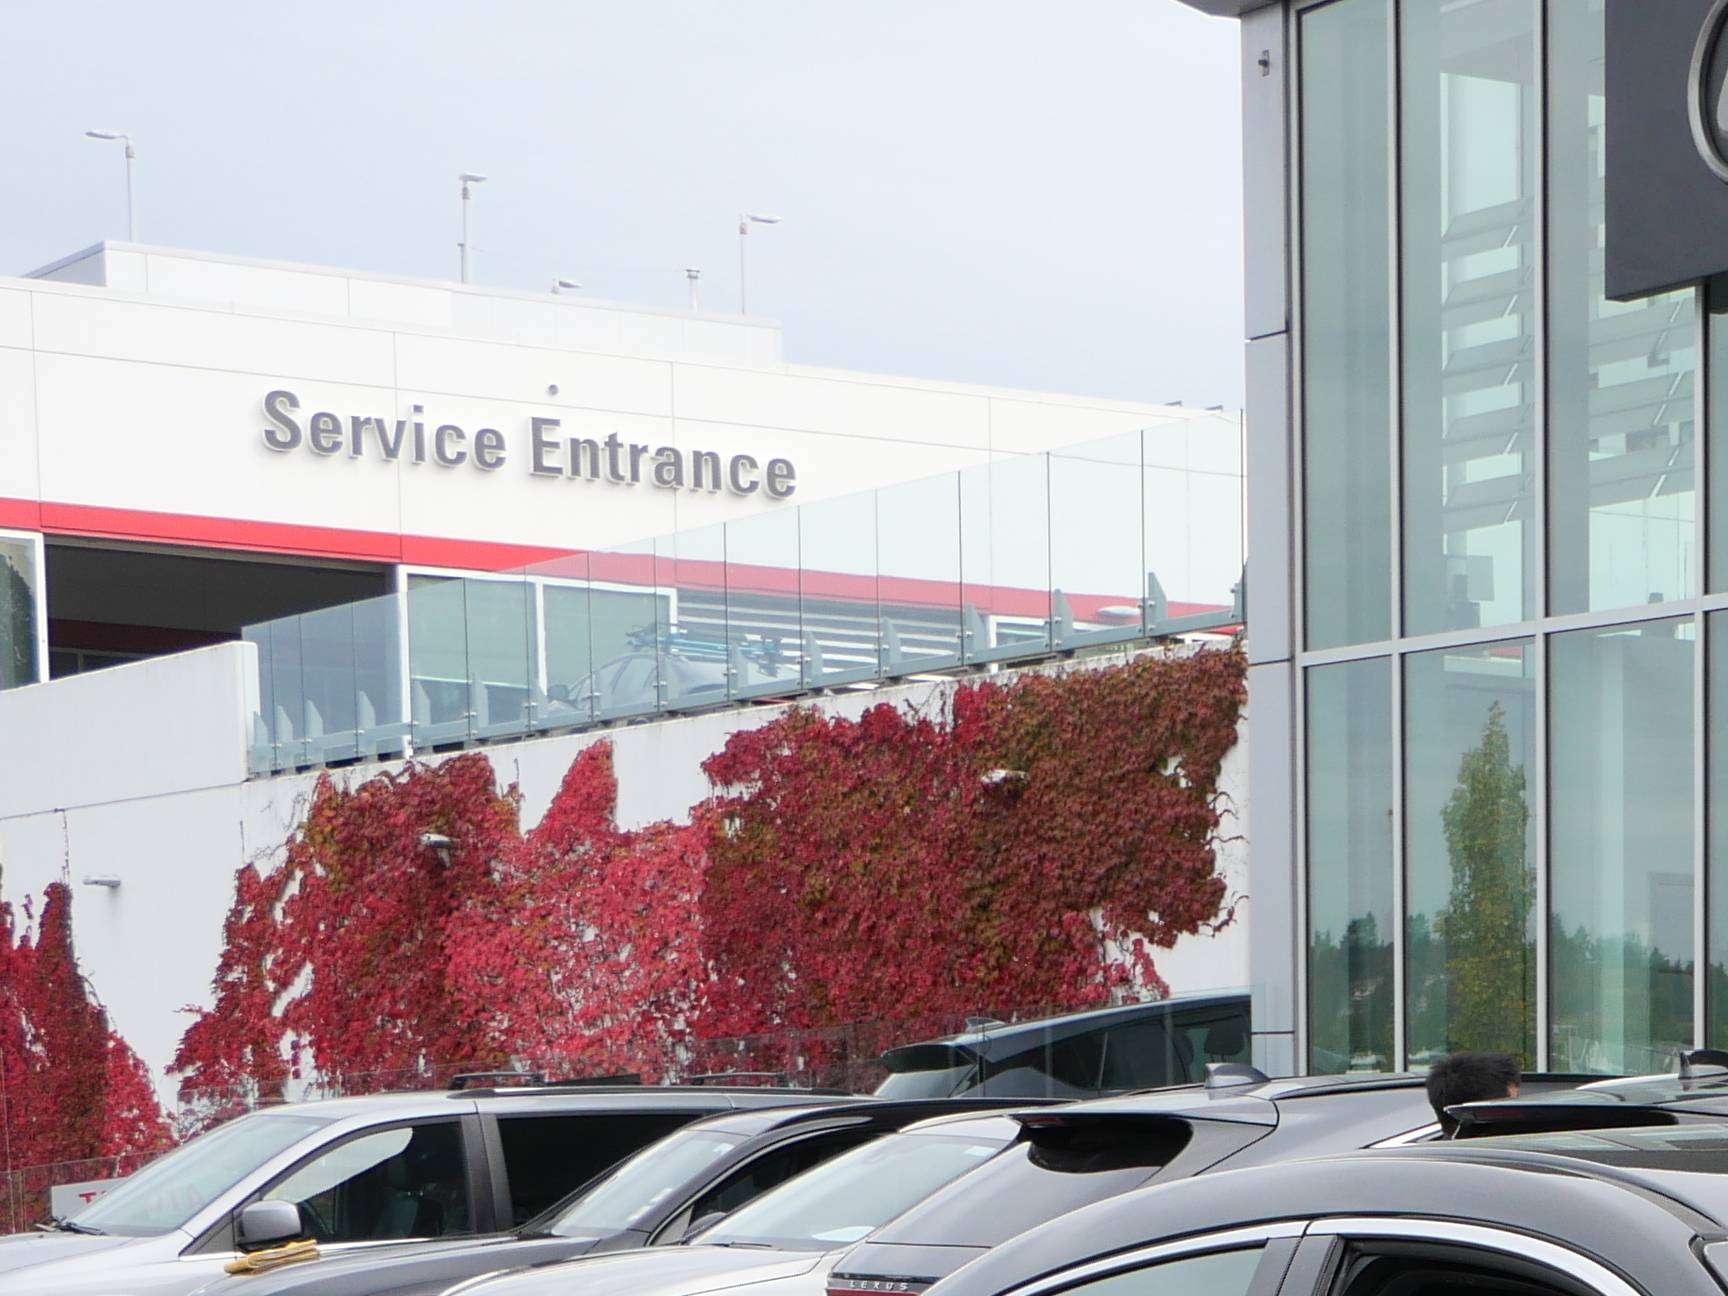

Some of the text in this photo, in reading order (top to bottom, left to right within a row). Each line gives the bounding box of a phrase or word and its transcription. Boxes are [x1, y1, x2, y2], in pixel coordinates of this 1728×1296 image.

[262, 390, 798, 500] Service Entrance
[848, 1280, 909, 1291] LEXUS
